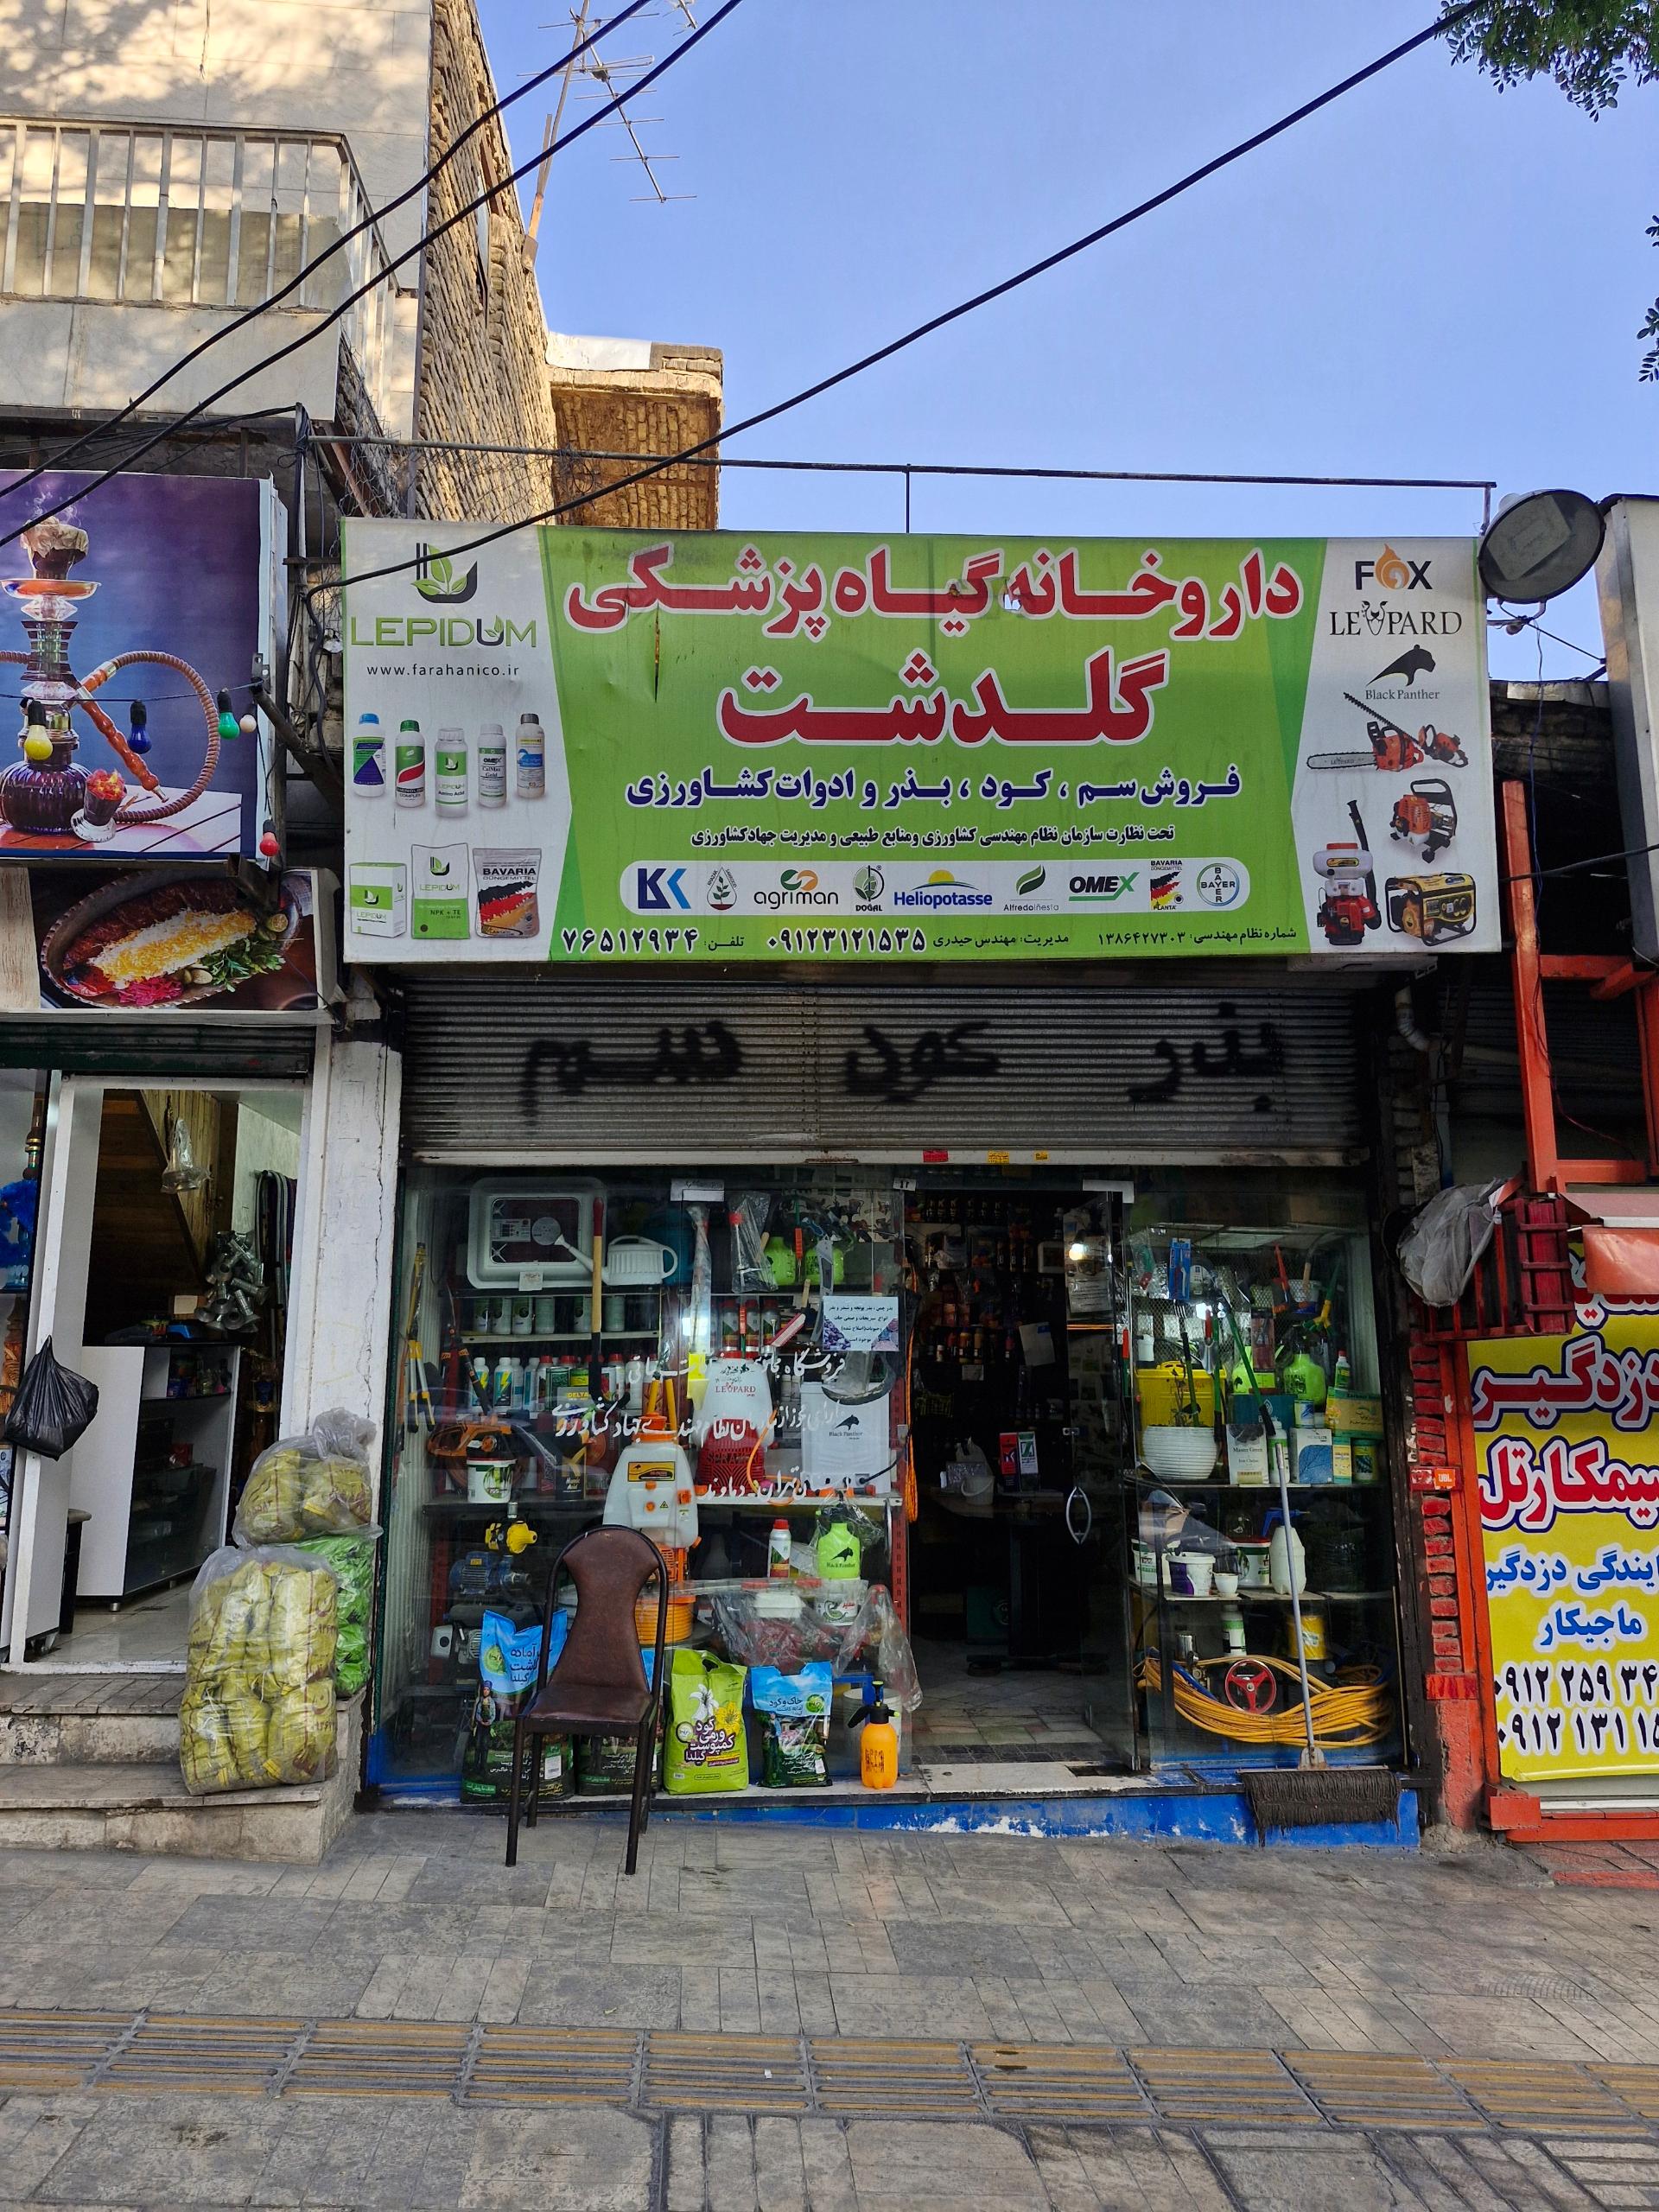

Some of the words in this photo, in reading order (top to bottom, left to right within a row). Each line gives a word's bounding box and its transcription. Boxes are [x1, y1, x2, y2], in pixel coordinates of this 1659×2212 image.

[1355, 552, 1433, 590] FOX
[568, 543, 825, 638] پزشکی
[834, 546, 1006, 634] گیاه
[1007, 550, 1303, 638] داروخانه
[1329, 603, 1462, 636] LEOPARD
[351, 616, 537, 649] LEPIDUM
[366, 663, 518, 677] www.farahanico.ir
[719, 648, 1167, 744] گلدشت
[1365, 690, 1396, 701] Black
[1397, 690, 1440, 701] Panther
[627, 767, 773, 806] کشاورزی
[776, 769, 855, 807] ادوات
[861, 782, 877, 807] و
[884, 769, 951, 808] بذر
[981, 770, 1052, 807] کود
[1141, 766, 1241, 805] فروش
[780, 830, 826, 848] مدیریت
[830, 836, 837, 849] و
[840, 827, 879, 847] طبیعی
[922, 827, 976, 847] کشاورزی
[980, 828, 1027, 846] مهندسی
[1030, 826, 1058, 846] نظام
[1061, 826, 1103, 845] سازمان
[1106, 825, 1144, 844] نظارت
[1147, 825, 1175, 841] تحت
[483, 868, 537, 876] BAVARIA
[420, 882, 461, 892] LEPIDUM
[1069, 872, 1141, 893] OMEX
[753, 890, 839, 910] agriman
[893, 891, 993, 909] Heliopotasse
[563, 929, 698, 953] ۷۶۵۱۲۹۳۴
[768, 929, 925, 952] ۰۹۱۲۳۱۲۱۵۳۵
[932, 935, 973, 949] حیدری
[975, 935, 1016, 948] مهندس
[1020, 933, 1070, 948] مدیریت:
[1098, 931, 1186, 945] ۱۳۸۶۴۲۷۳۰۳
[1190, 929, 1238, 944] مهندسی:
[1239, 927, 1263, 944] نظام
[1264, 926, 1297, 939] شماره
[785, 1347, 846, 1382] فروشگاه
[1478, 1446, 1659, 1522] یمکارتل
[1486, 1550, 1567, 1592] دزدگیر
[1560, 1665, 1611, 1703] ۲۵۹
[769, 1698, 782, 1708] کود
[787, 1696, 803, 1706] خاک
[696, 1718, 715, 1733] کود
[1497, 1713, 1561, 1751] ۰۹۱۲
[1575, 1712, 1628, 1751] ۱۳۱
[690, 1735, 735, 1754] کمپوست
[699, 1731, 726, 1744] ورمی
[685, 1750, 706, 1764] گیلدا
